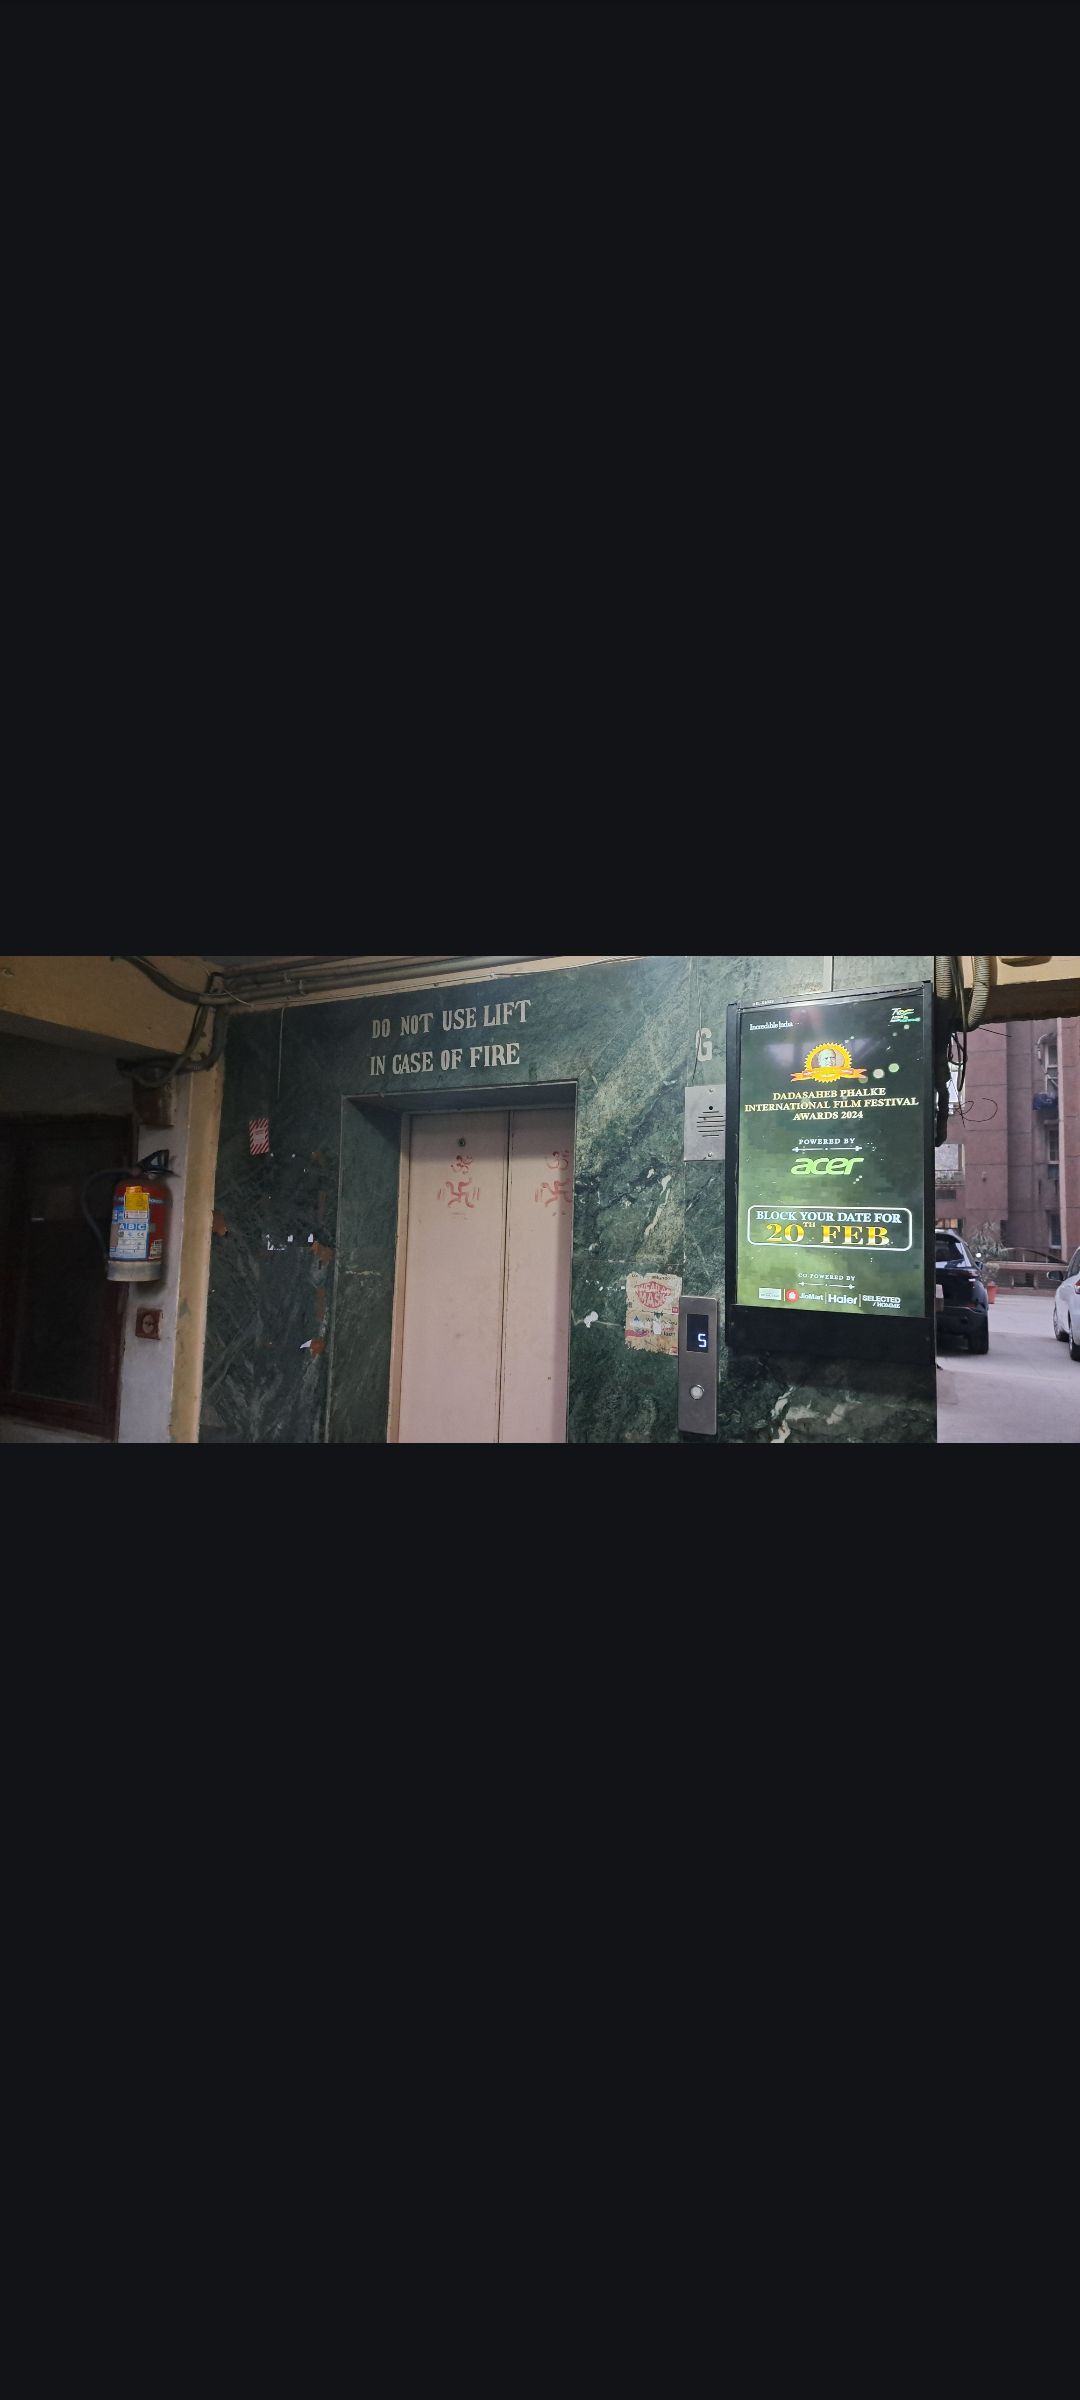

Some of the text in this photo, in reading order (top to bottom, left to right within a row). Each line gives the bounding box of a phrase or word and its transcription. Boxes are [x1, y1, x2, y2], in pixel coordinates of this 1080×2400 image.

[372, 999, 532, 1039] DO NOT USE LIFT
[749, 1021, 778, 1031] Incredible
[695, 1027, 713, 1062] G
[370, 1042, 520, 1076] IN CASE OF FIRE
[772, 1087, 887, 1101] DADASAHEB PHALKE
[744, 1097, 919, 1112] INTERNATIONAL FILM FESTIVAL
[793, 1110, 864, 1121] AWARDS 2024
[790, 1157, 865, 1175] acer
[756, 1210, 902, 1224] BLOCK YOUR DATE FOR
[820, 1225, 890, 1246] FEB
[799, 1293, 824, 1301] JioMart
[828, 1293, 858, 1305] Haier
[862, 1294, 901, 1304] SELECTED
